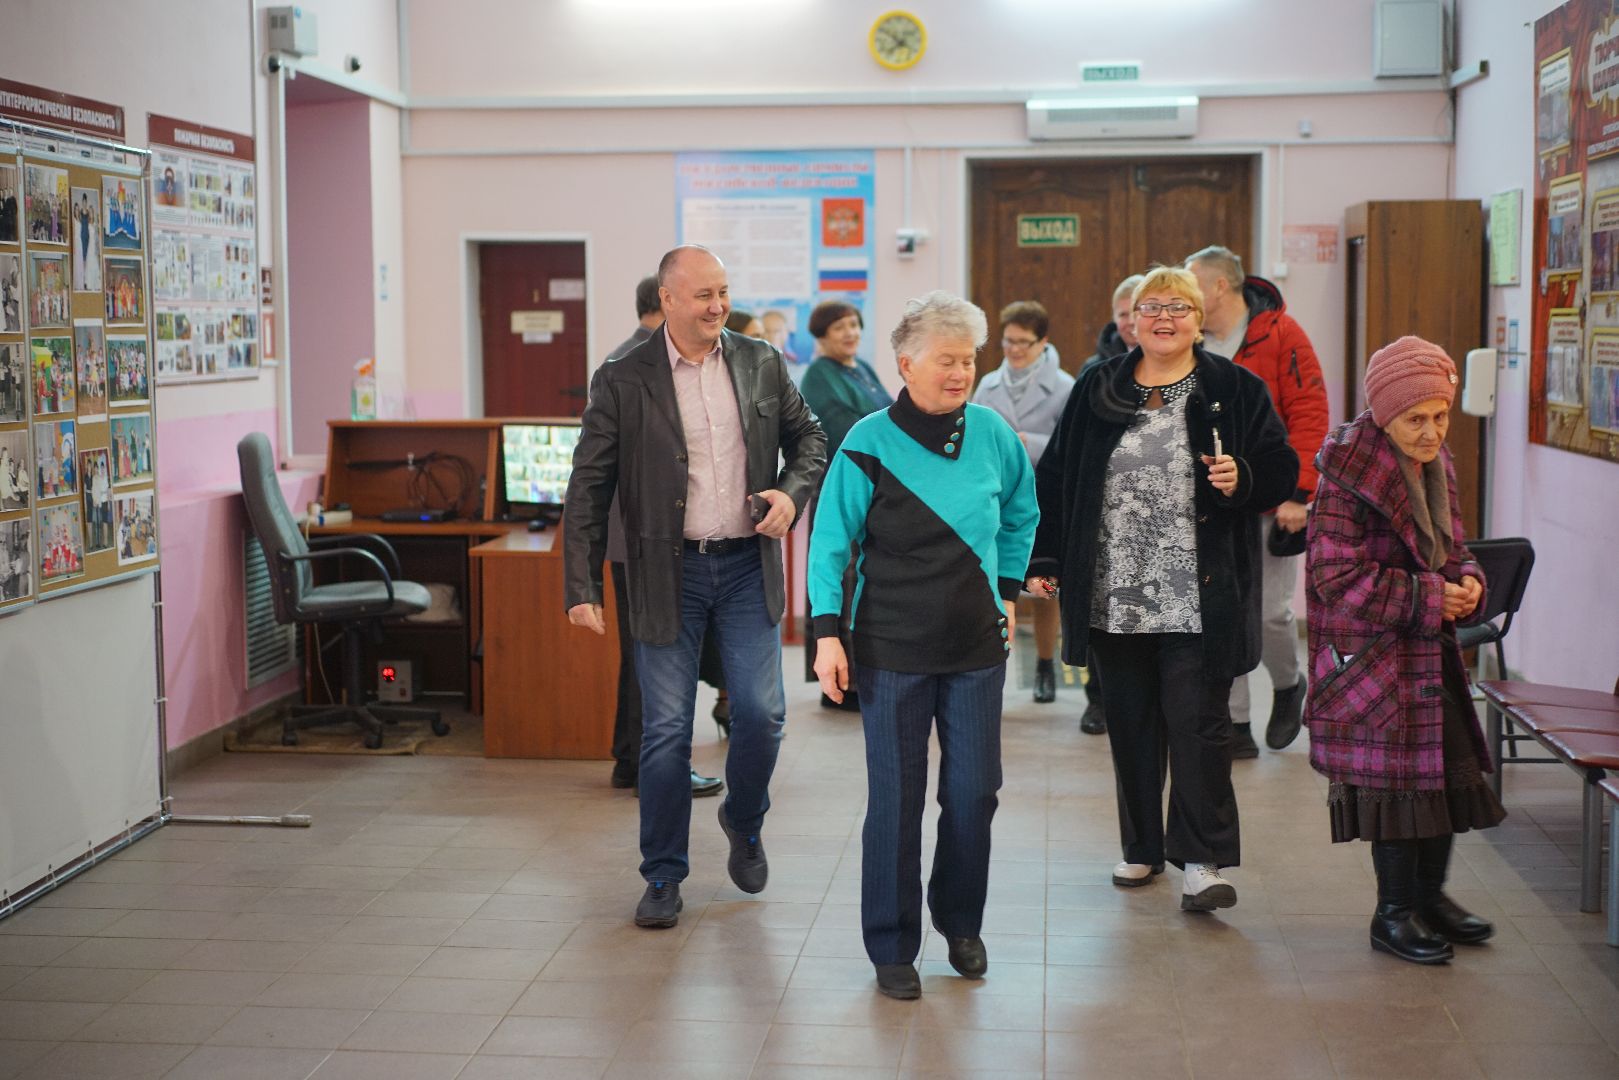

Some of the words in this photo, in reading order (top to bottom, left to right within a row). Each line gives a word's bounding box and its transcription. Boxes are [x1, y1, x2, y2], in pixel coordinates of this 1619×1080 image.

[1086, 67, 1136, 79] ВЫХОД
[73, 106, 116, 130] БЕЗОПАСНОСТЬ
[1021, 221, 1074, 242] ВЫХОД
